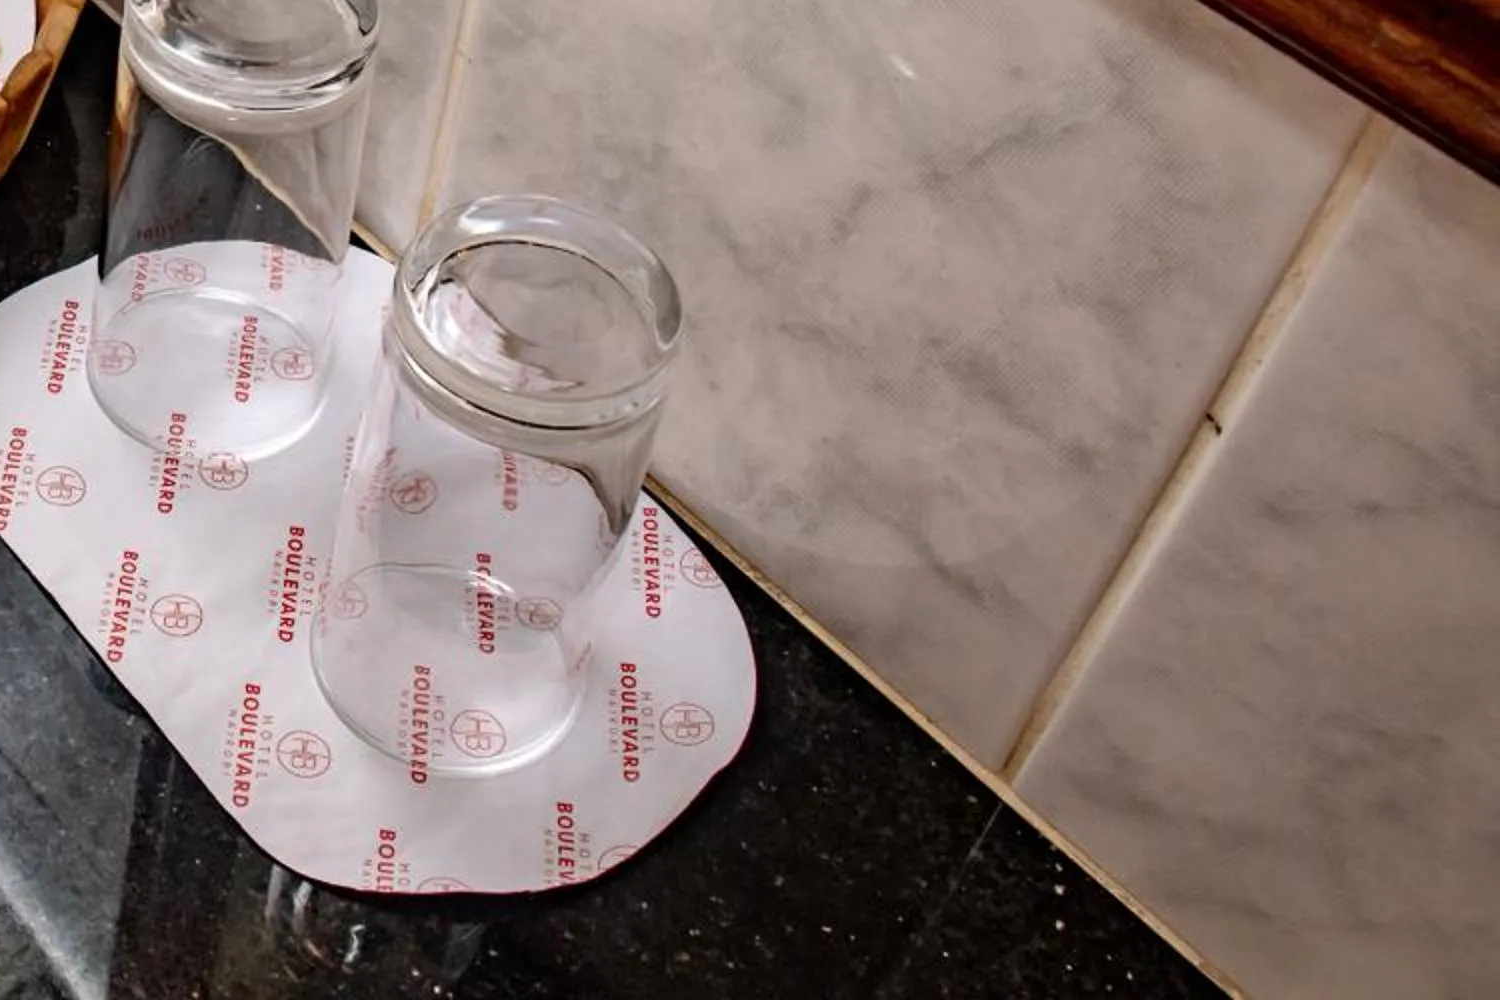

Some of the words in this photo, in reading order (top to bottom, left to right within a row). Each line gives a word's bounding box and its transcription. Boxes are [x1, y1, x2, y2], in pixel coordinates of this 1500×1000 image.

[47, 300, 80, 395] BOULEVARD
[235, 316, 258, 402] BOULEVARD
[107, 550, 139, 663] BOULEVARD
[131, 578, 148, 635] HOTEL
[278, 526, 305, 643] BOULEVARD
[300, 556, 316, 616] HOTEL
[477, 553, 495, 654] BOLEVARD
[643, 507, 661, 618] BOULEVARD
[232, 683, 261, 807] BOULEVARD
[256, 714, 274, 778] HOTEL
[411, 665, 430, 784] BOULEVARD
[621, 663, 640, 782] BOULEVARD
[641, 691, 655, 753] HOTEL
[376, 829, 397, 892] BOULE
[557, 803, 575, 881] BOULEV
[579, 832, 592, 871] HOT
